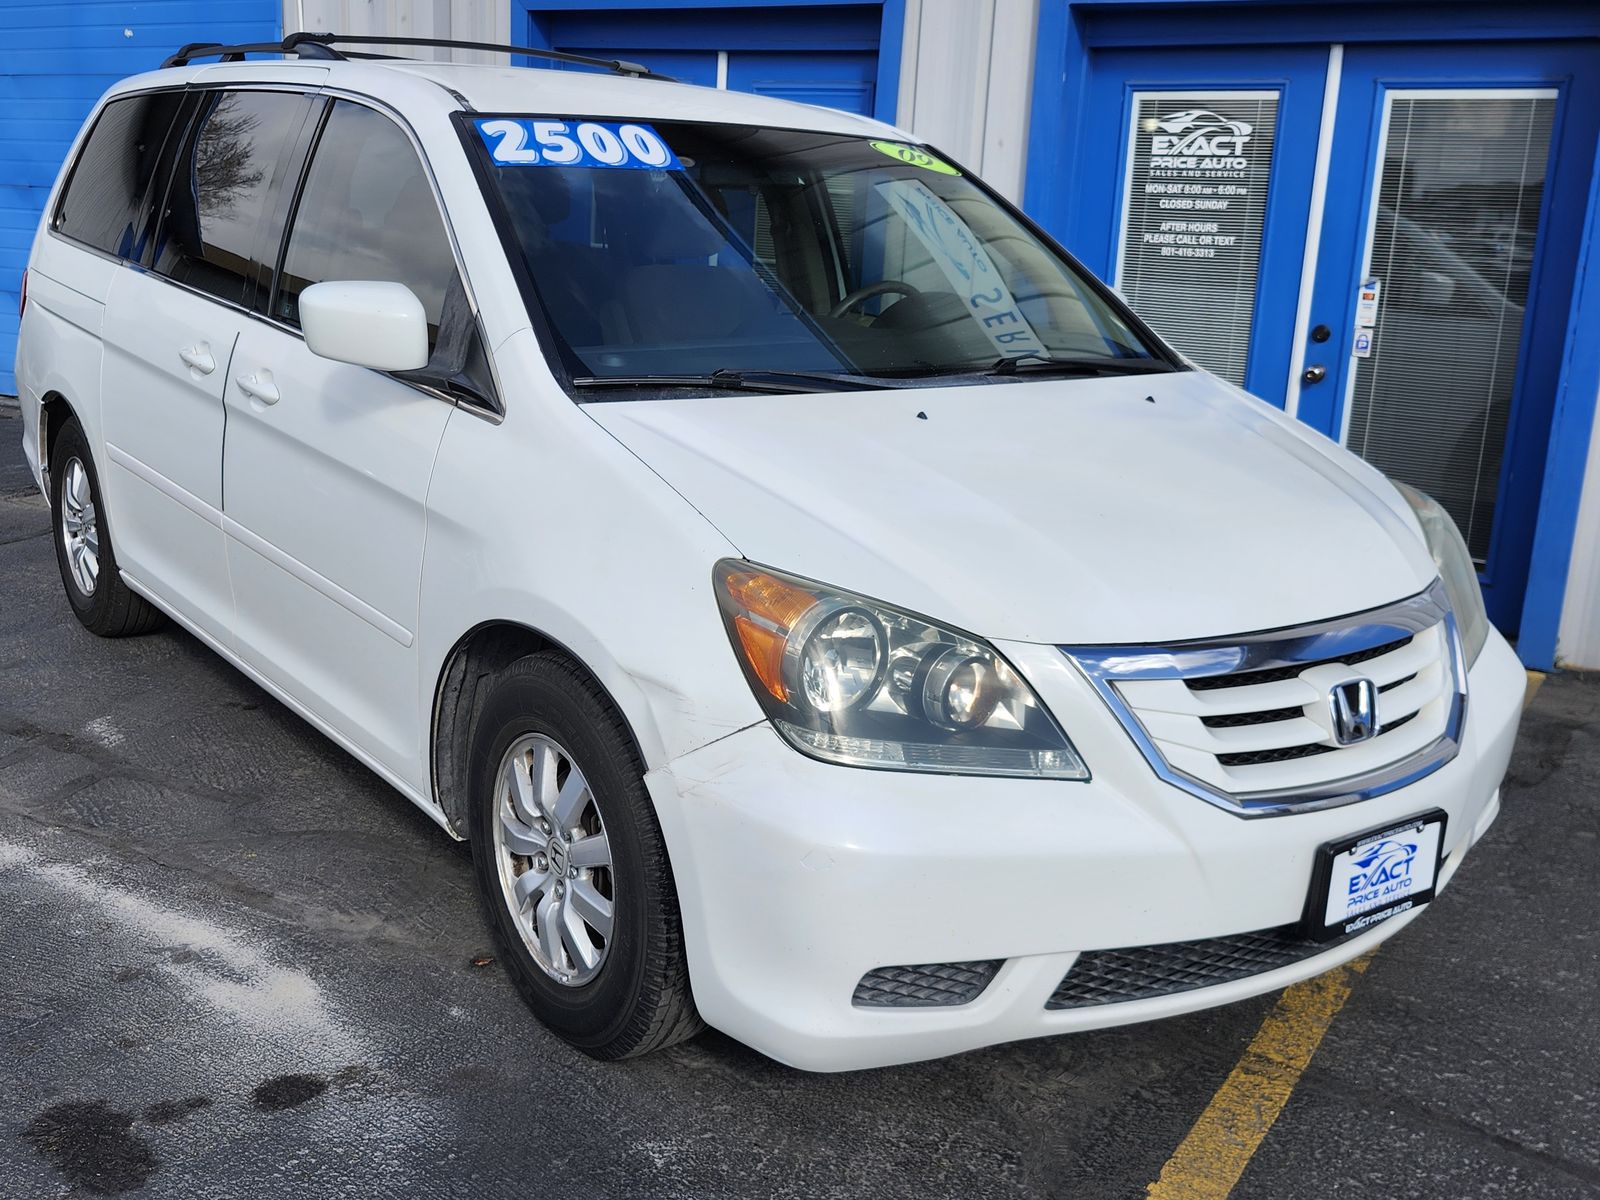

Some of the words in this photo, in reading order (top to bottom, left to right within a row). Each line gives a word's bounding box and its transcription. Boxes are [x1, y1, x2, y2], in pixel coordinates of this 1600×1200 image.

[481, 120, 672, 167] 2500
[1151, 135, 1252, 156] EXACT
[1150, 157, 1197, 169] PRICE
[1200, 157, 1247, 170] AUTO
[1205, 170, 1246, 178] SERVICE
[1159, 199, 1193, 209] CLOSED
[1194, 200, 1229, 210] SUNDAY
[1160, 222, 1187, 232] AFTER
[1188, 223, 1218, 233] HOURS
[1143, 233, 1175, 244] PLEASE
[1176, 234, 1198, 245] CALL
[1199, 235, 1213, 245] OR
[1214, 236, 1236, 246] TEXT
[1348, 856, 1415, 895] EXACT
[1347, 888, 1379, 909] PRICE
[1383, 878, 1412, 895] AUTO
[1345, 916, 1371, 933] EXACT
[1369, 908, 1392, 923] PRICE
[1392, 901, 1413, 917] AUTO
